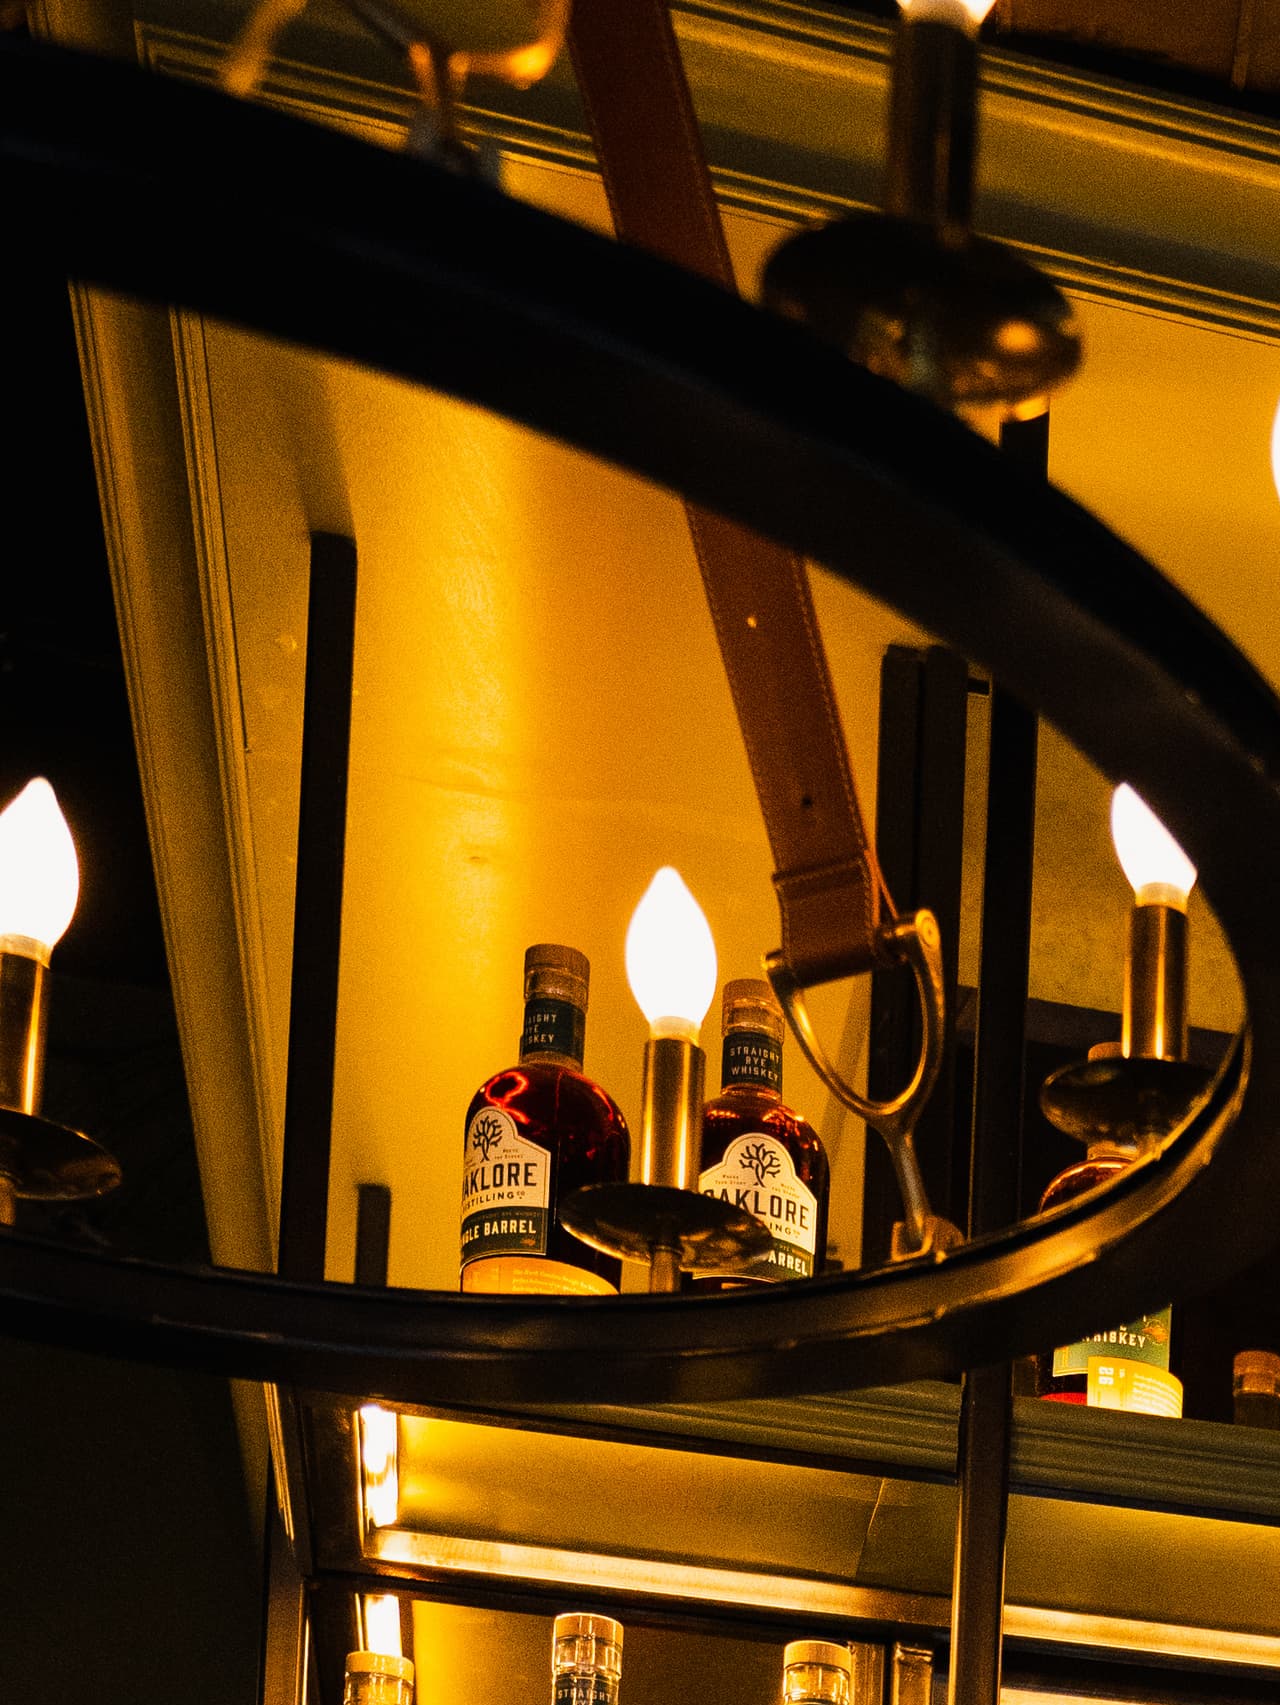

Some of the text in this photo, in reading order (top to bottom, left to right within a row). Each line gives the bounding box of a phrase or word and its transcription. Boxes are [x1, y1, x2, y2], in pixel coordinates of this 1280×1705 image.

[730, 1046, 780, 1063] STRAIGHT
[746, 1056, 765, 1068] RYE
[731, 1066, 778, 1081] WHISKEY
[463, 1163, 537, 1197] AKLORE
[484, 1220, 536, 1236] BARREL
[768, 1251, 808, 1276] ARREL
